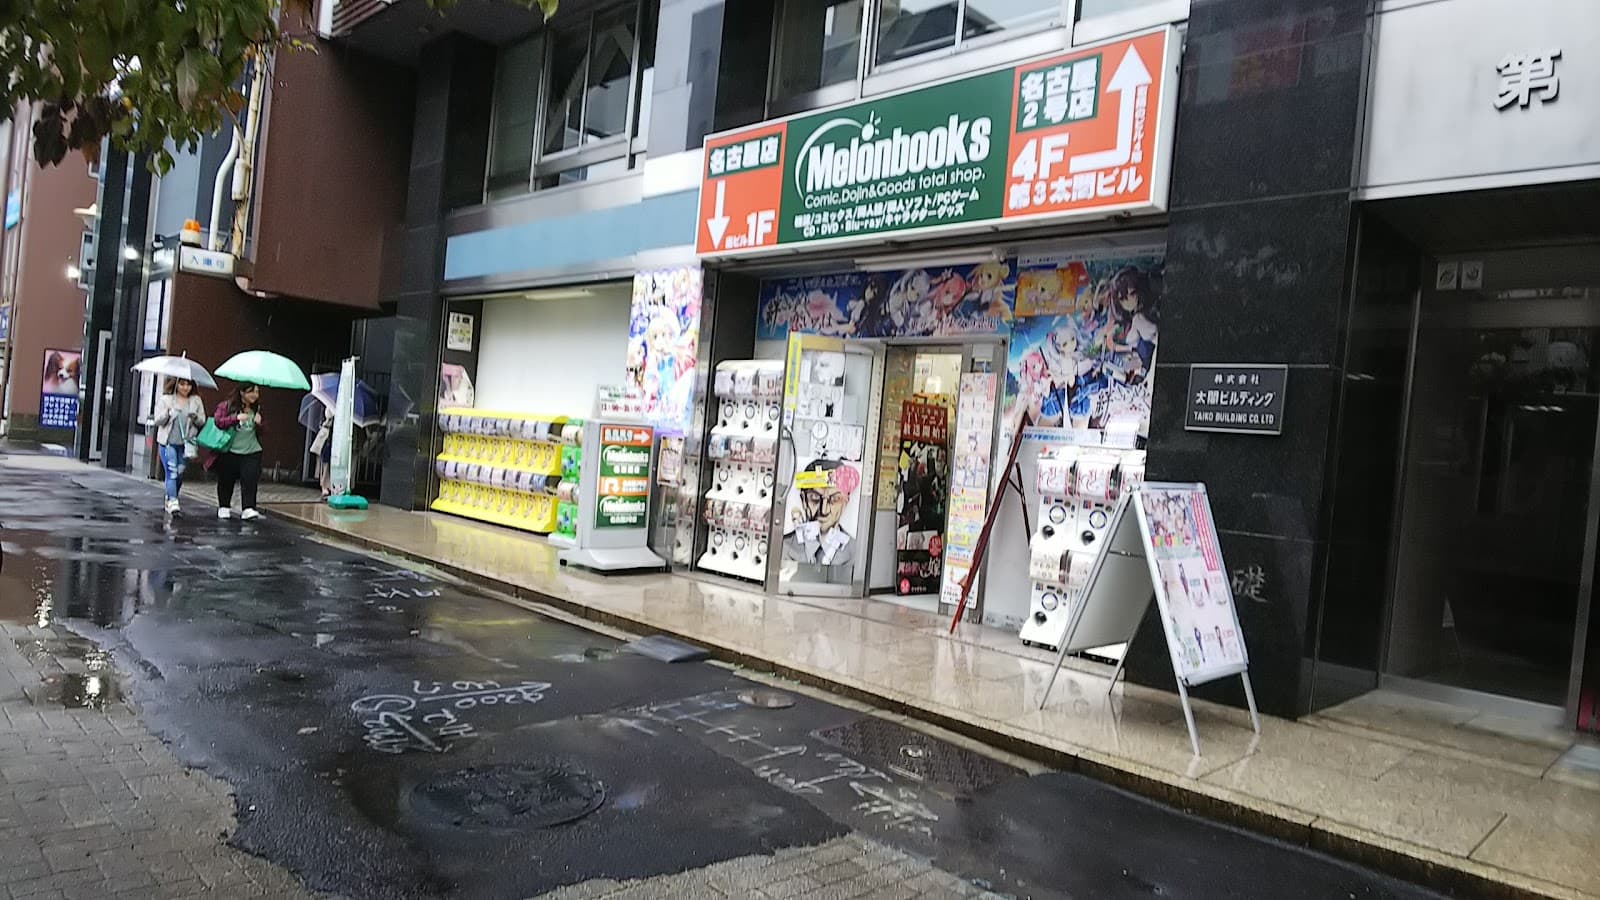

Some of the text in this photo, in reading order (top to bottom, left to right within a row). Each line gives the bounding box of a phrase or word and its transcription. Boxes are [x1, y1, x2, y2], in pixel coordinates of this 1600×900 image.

[1492, 47, 1562, 112] 第
[806, 113, 992, 193] Melonbooks
[1012, 132, 1070, 181] 4F
[919, 170, 947, 191] total
[746, 209, 776, 247] 1F
[1193, 411, 1214, 422] TAIKO
[1215, 412, 1247, 423] BUILDING
